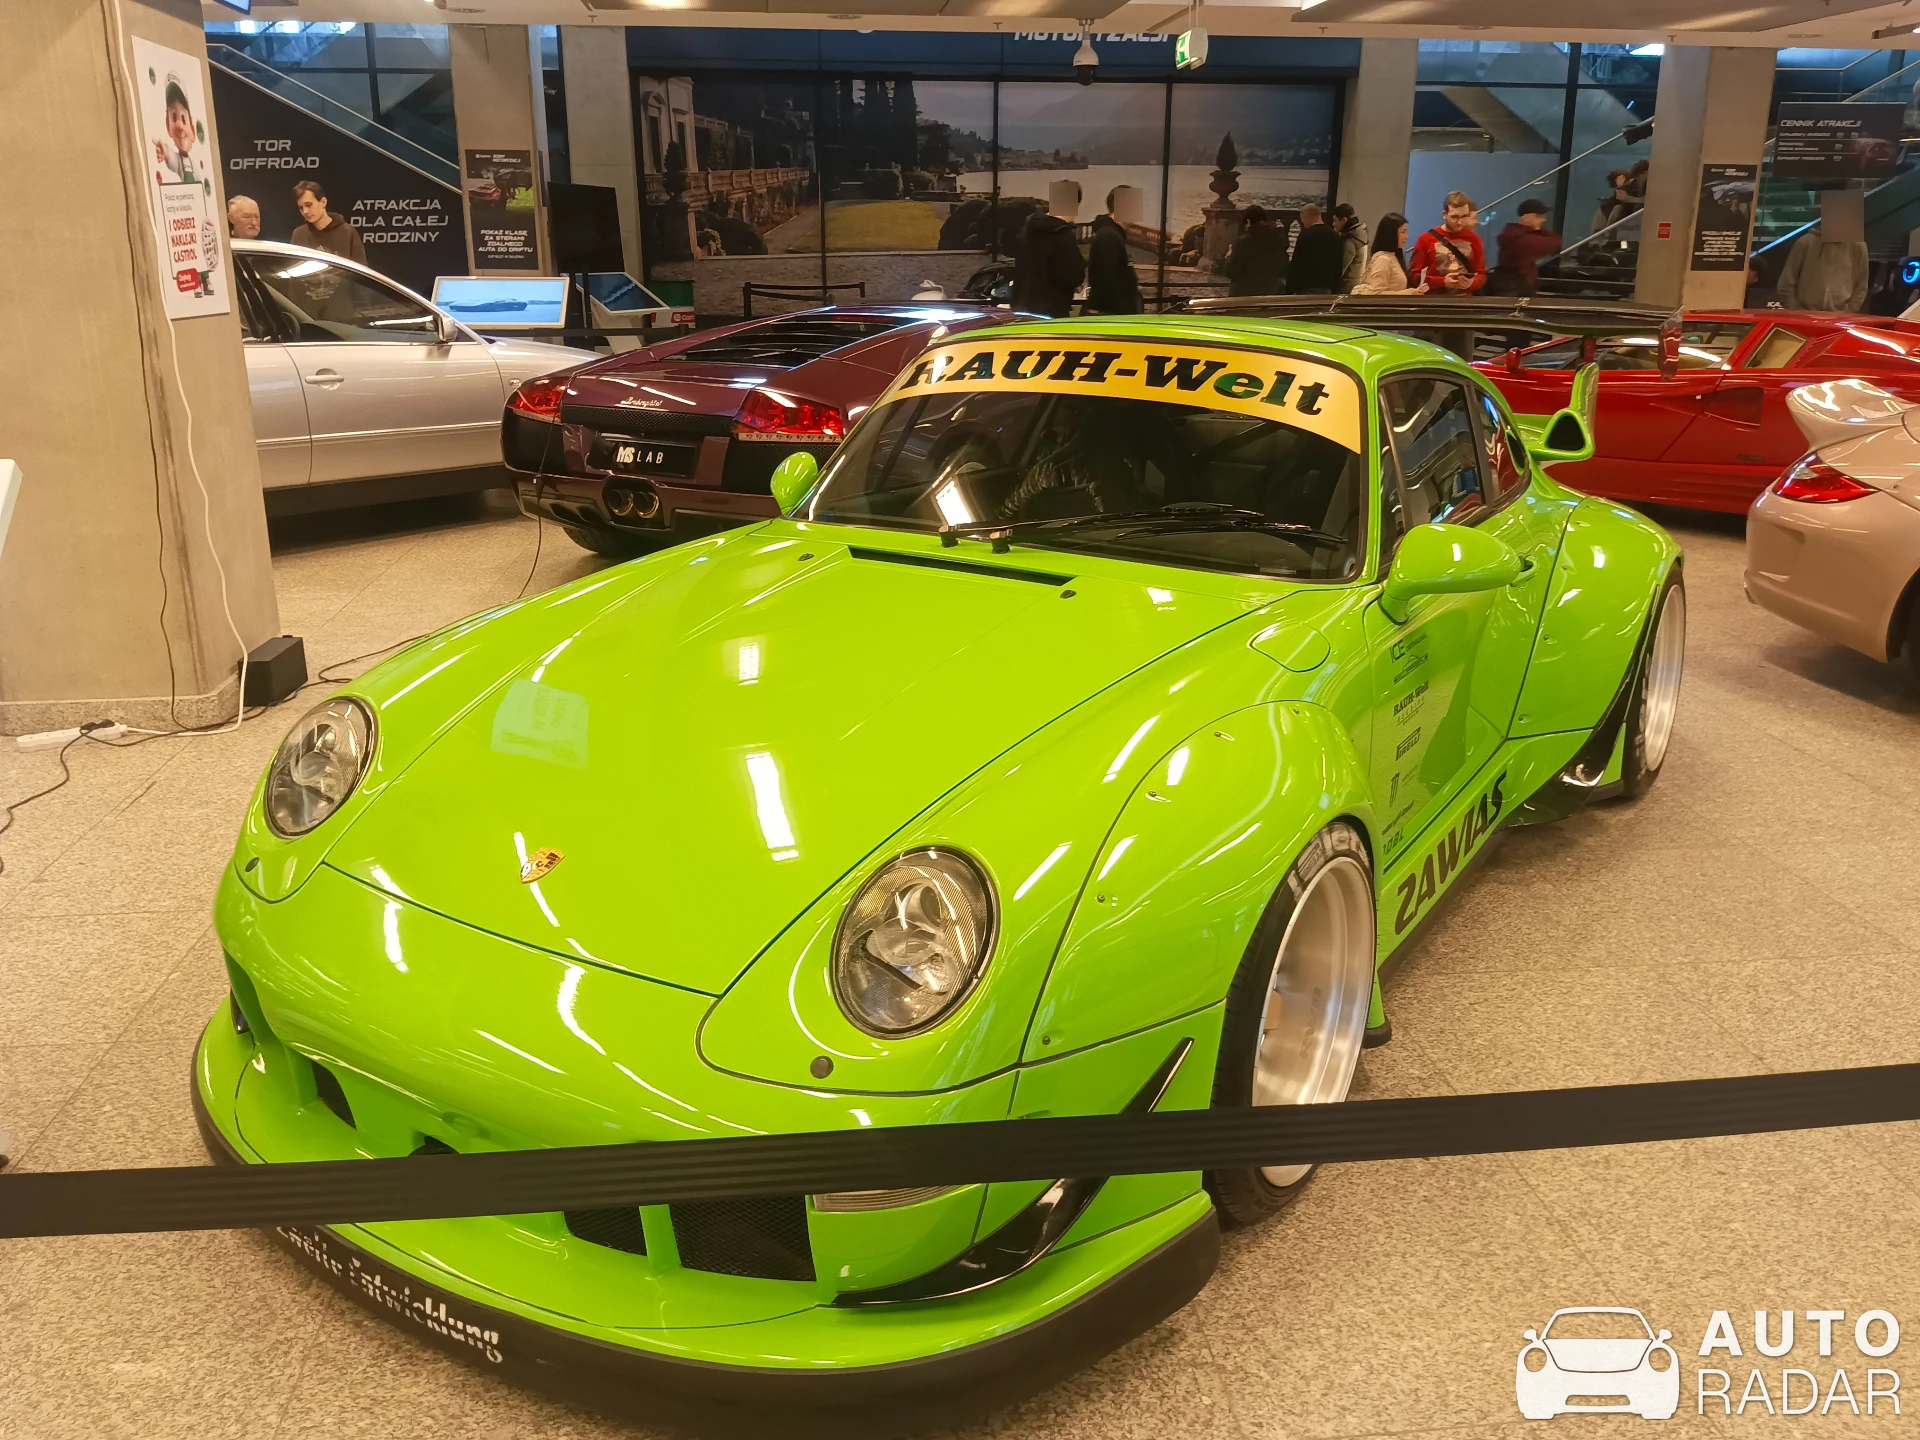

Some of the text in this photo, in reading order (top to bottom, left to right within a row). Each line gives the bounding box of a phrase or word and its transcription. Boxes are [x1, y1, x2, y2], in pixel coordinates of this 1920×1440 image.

[253, 139, 292, 152] TOR
[229, 156, 320, 170] OFFROAD
[352, 199, 442, 211] ATRAKCJA
[168, 217, 196, 232] I ODBIERZ
[350, 215, 449, 228] DLA CAŁEJ
[171, 232, 197, 248] NAKLEJKI
[362, 232, 440, 243] RODZINY
[173, 248, 197, 263] CASTROL
[899, 349, 1330, 417] RAUH-Welt
[616, 446, 635, 463] MS
[1395, 726, 1421, 761] PIRELLI
